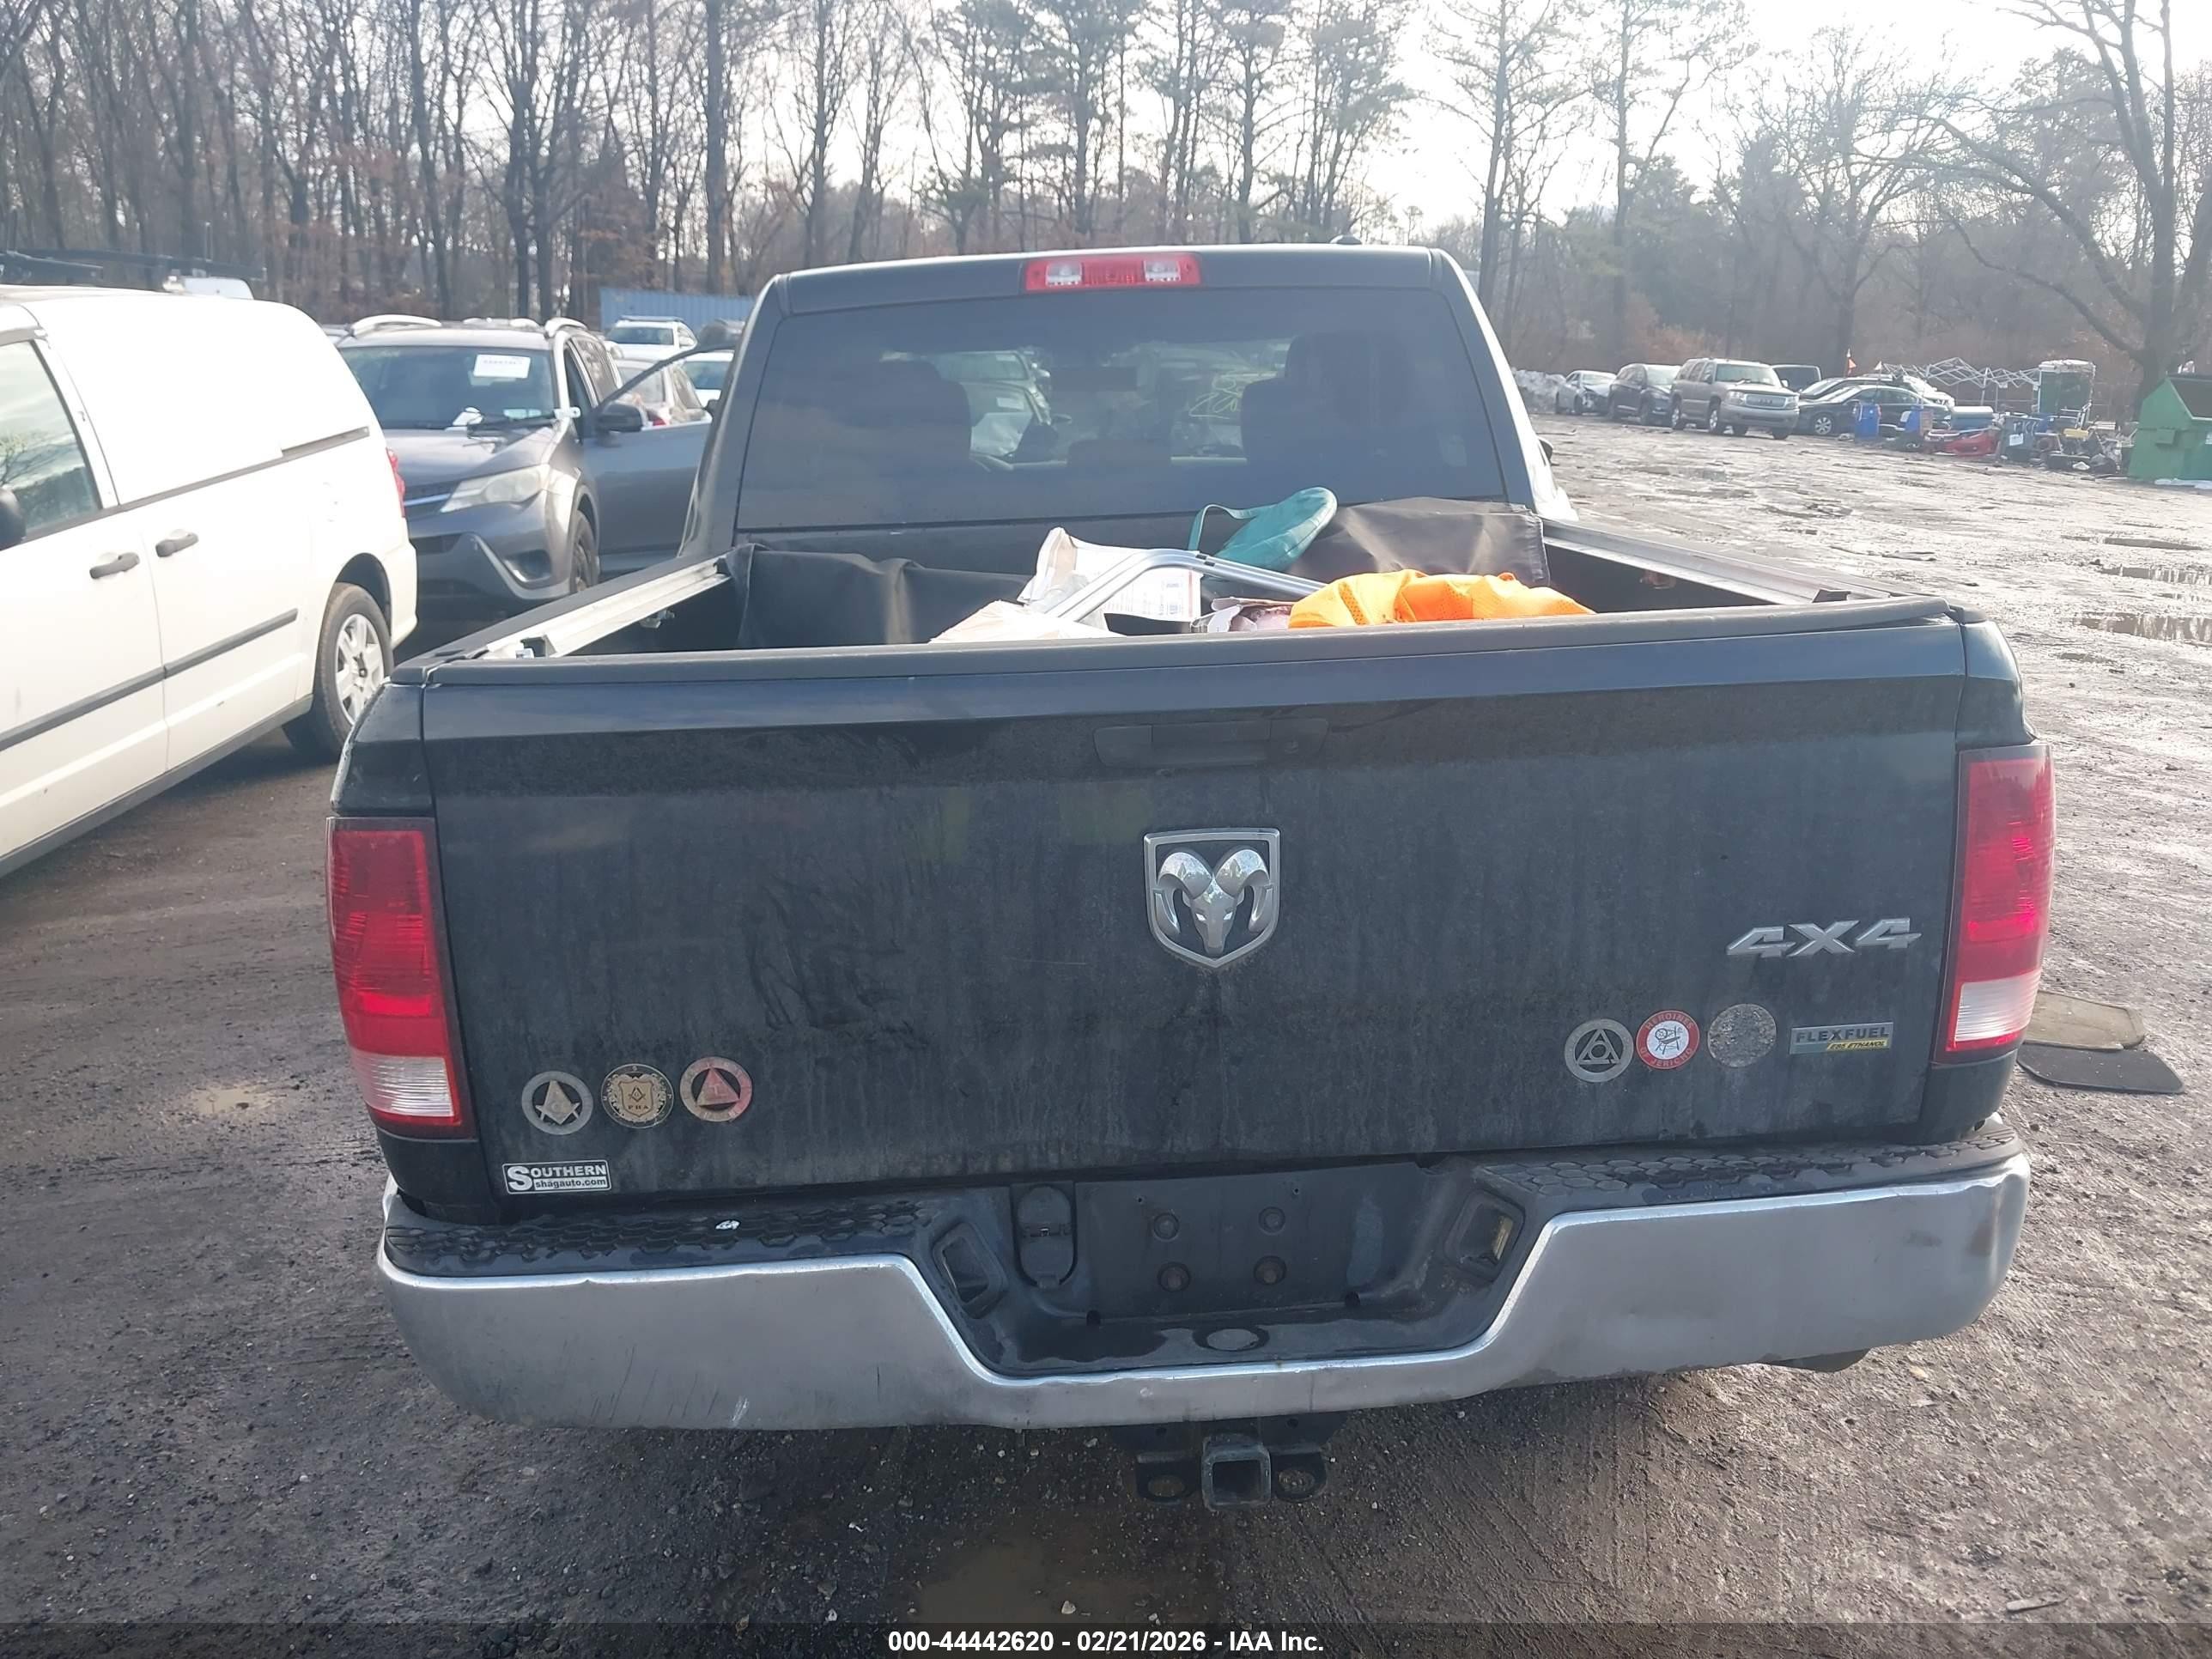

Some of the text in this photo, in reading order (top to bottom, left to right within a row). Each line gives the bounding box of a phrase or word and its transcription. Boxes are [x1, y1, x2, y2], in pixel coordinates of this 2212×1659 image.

[1726, 918, 1922, 958] 4X4
[1644, 1013, 1693, 1030] HEROINES
[1796, 1027, 1890, 1042] FLEXFUEL
[1847, 1040, 1886, 1048] ETHANOL
[1651, 1048, 1692, 1066] JERICHO
[507, 1165, 606, 1191] SOUTHERN
[535, 1178, 606, 1188] shagauto.com
